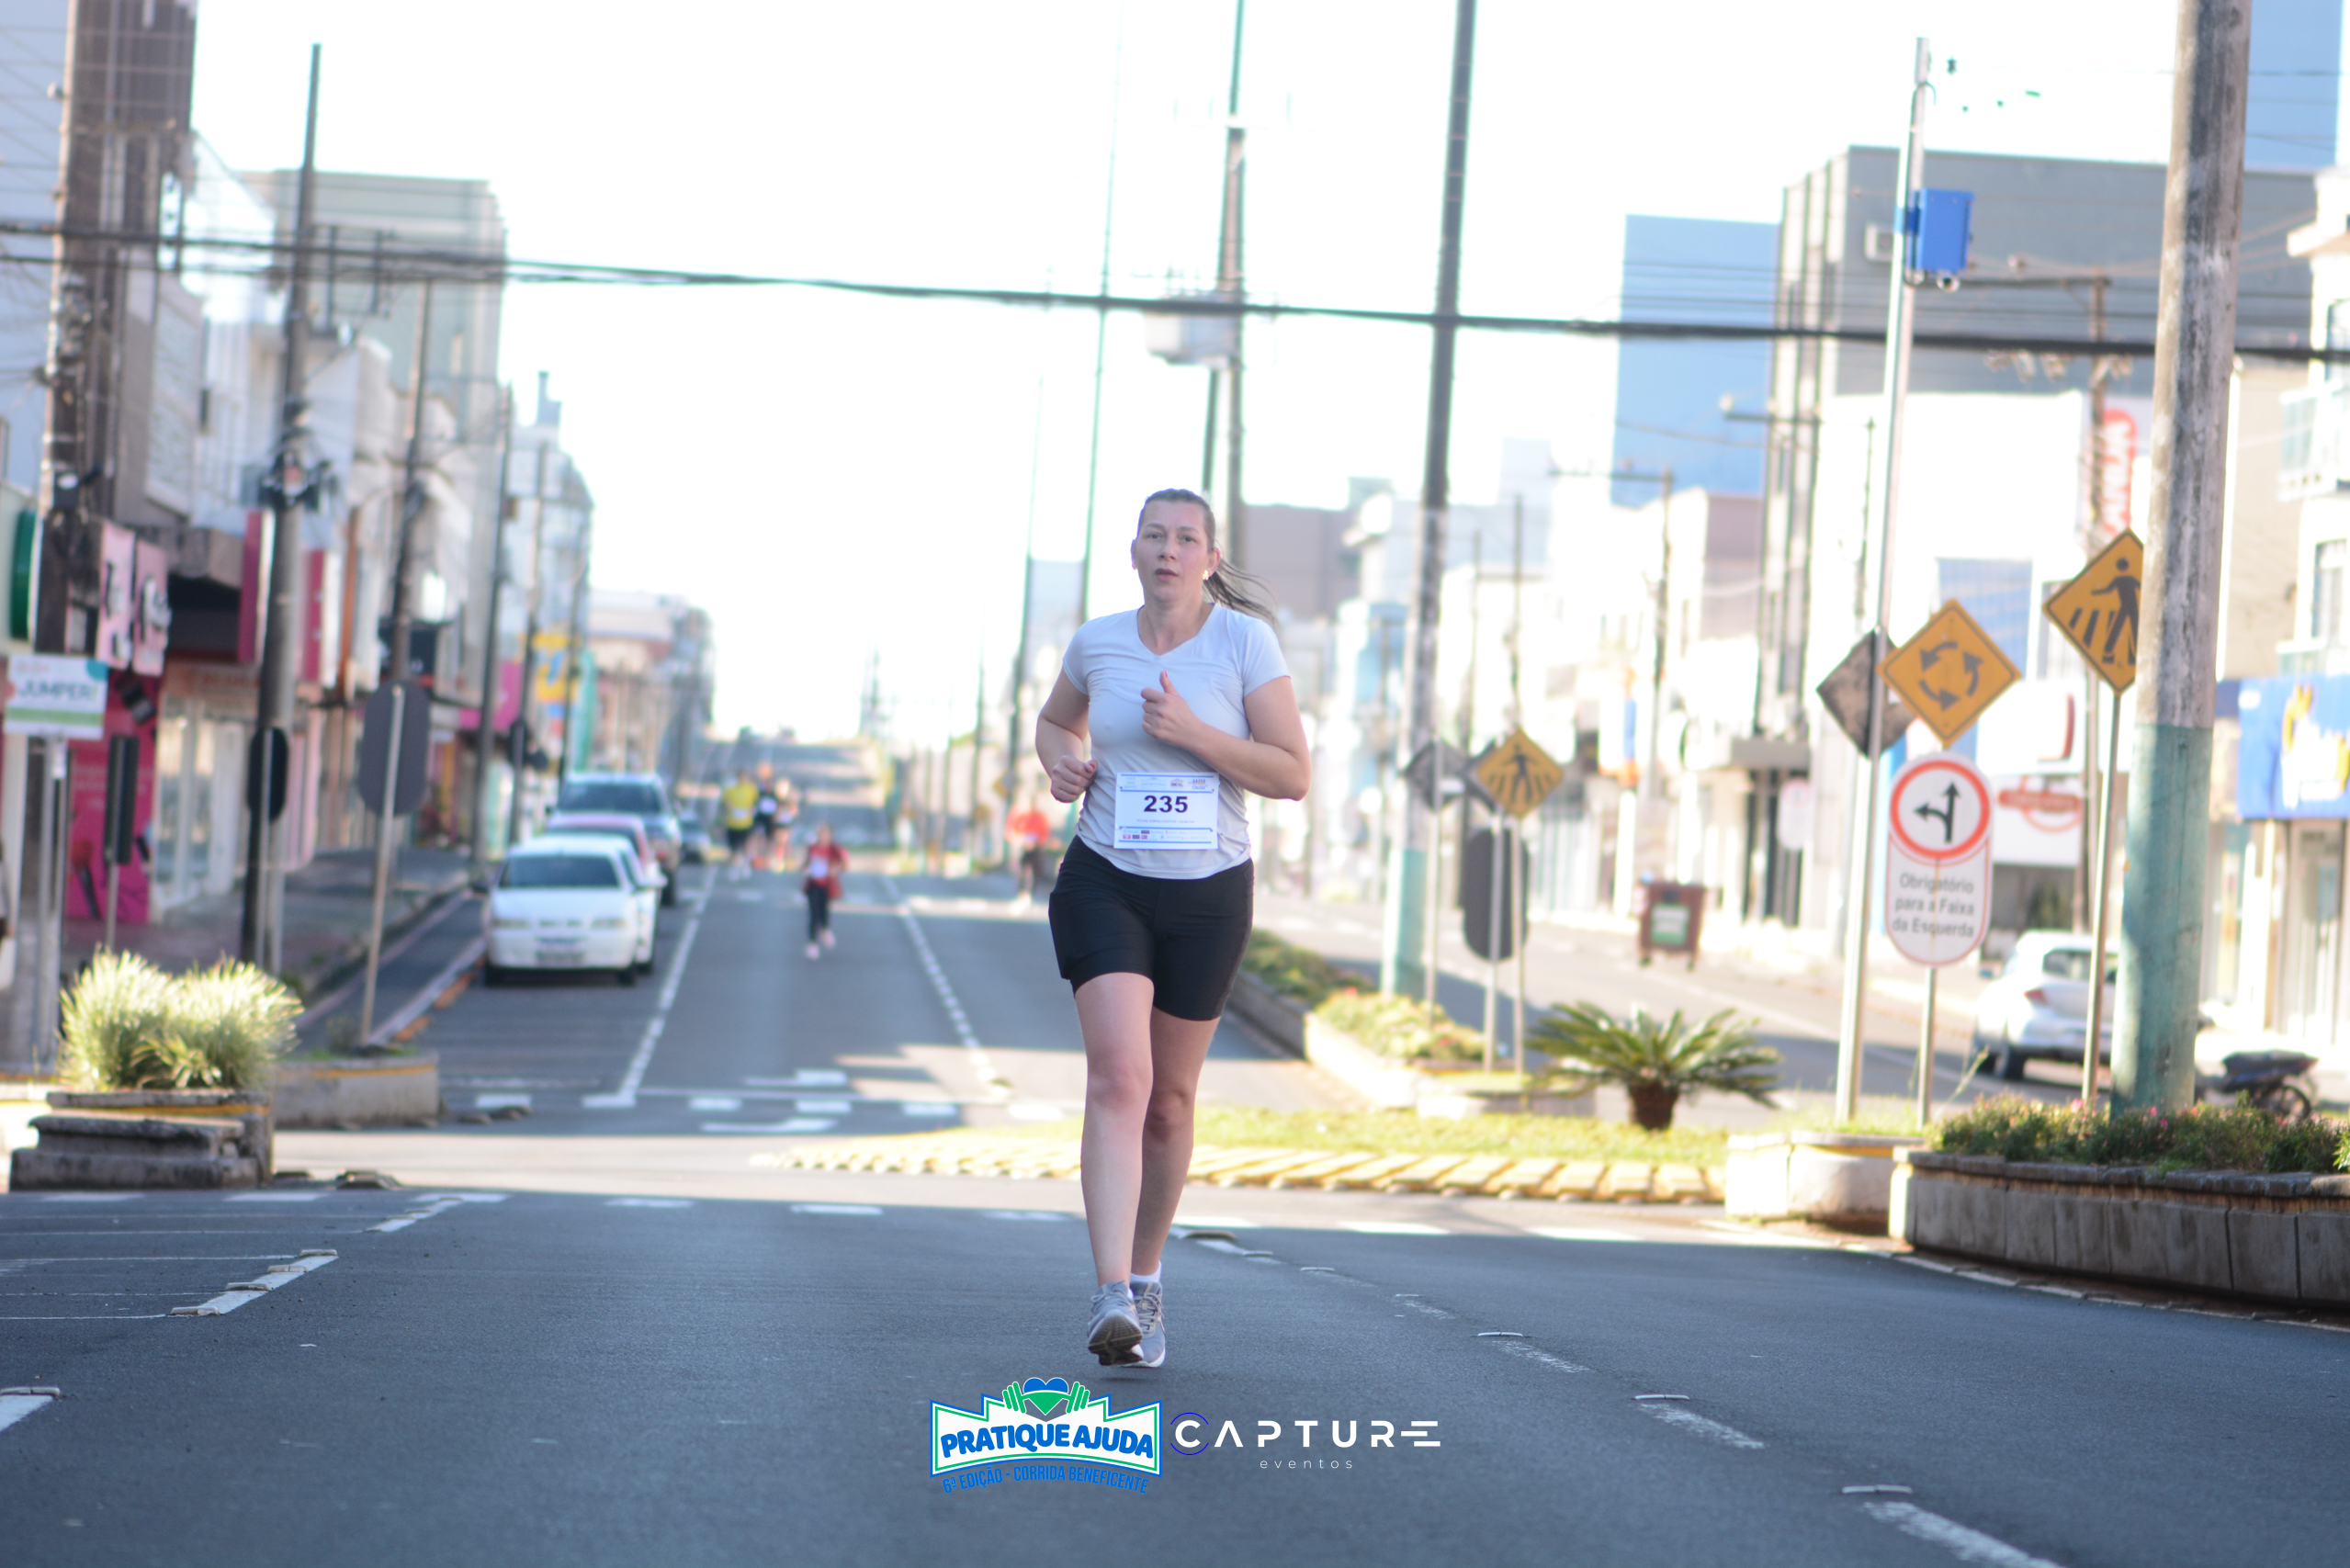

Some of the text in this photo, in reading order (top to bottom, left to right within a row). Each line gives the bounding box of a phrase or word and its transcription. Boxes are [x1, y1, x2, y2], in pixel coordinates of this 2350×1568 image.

[1144, 795, 1188, 813] 235
[1900, 873, 1974, 894] Obrigatório
[1895, 897, 1974, 915] para a Faixa
[1892, 918, 1974, 938] da Esquerda
